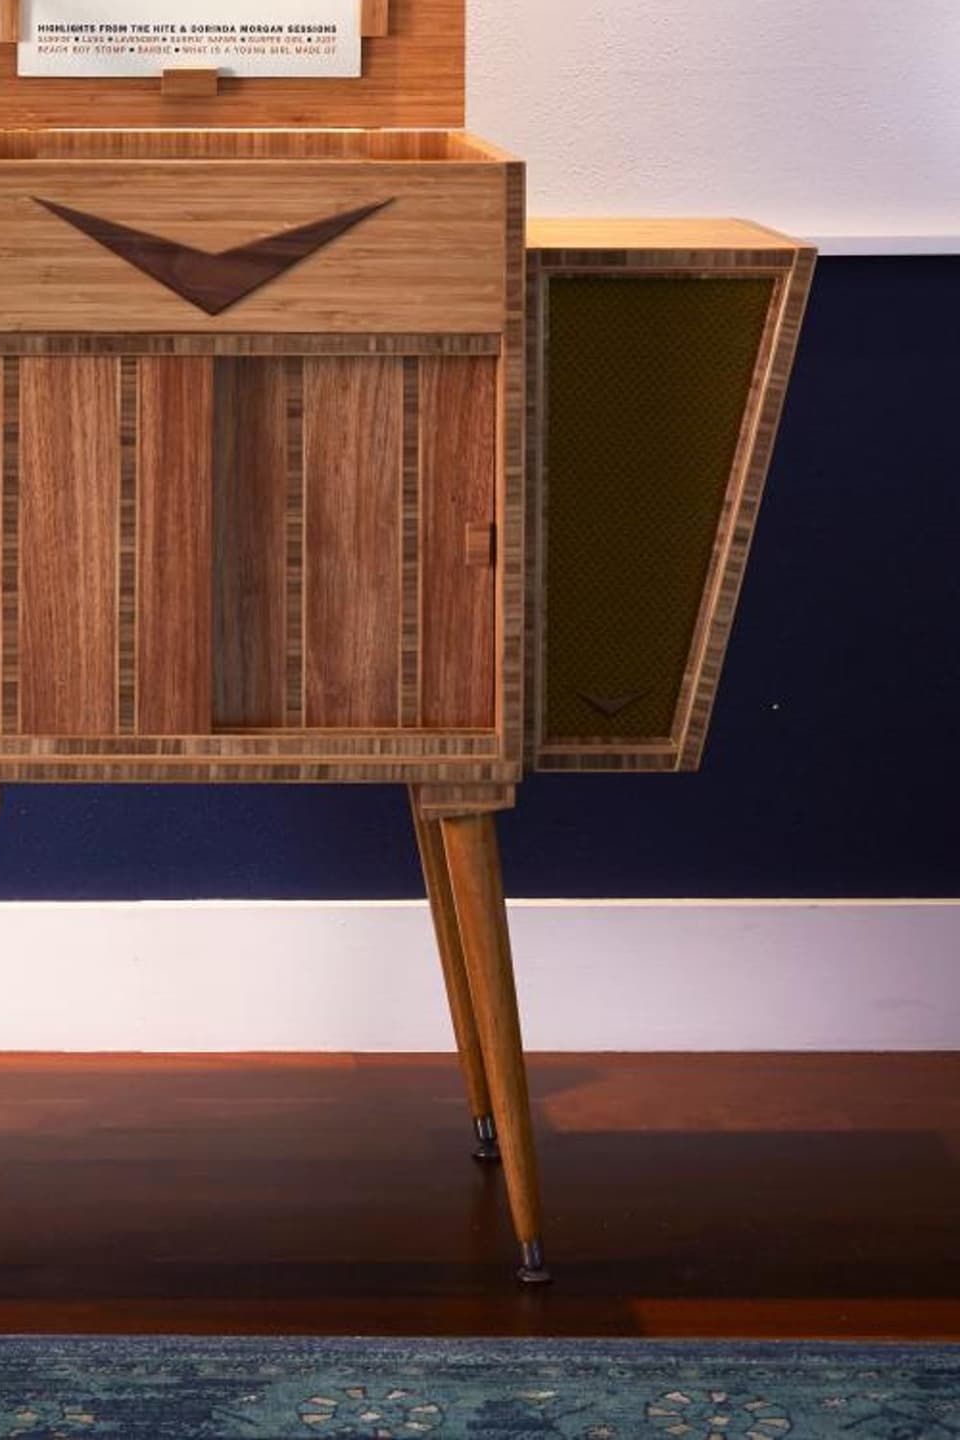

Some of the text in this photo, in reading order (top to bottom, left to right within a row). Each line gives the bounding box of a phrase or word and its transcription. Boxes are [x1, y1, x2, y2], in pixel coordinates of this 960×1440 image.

[38, 25, 95, 33] HIGHLIGHTS
[99, 25, 128, 33] FROM
[130, 25, 150, 33] THE
[240, 25, 284, 33] MORGAN
[288, 25, 337, 33] SESSIONS
